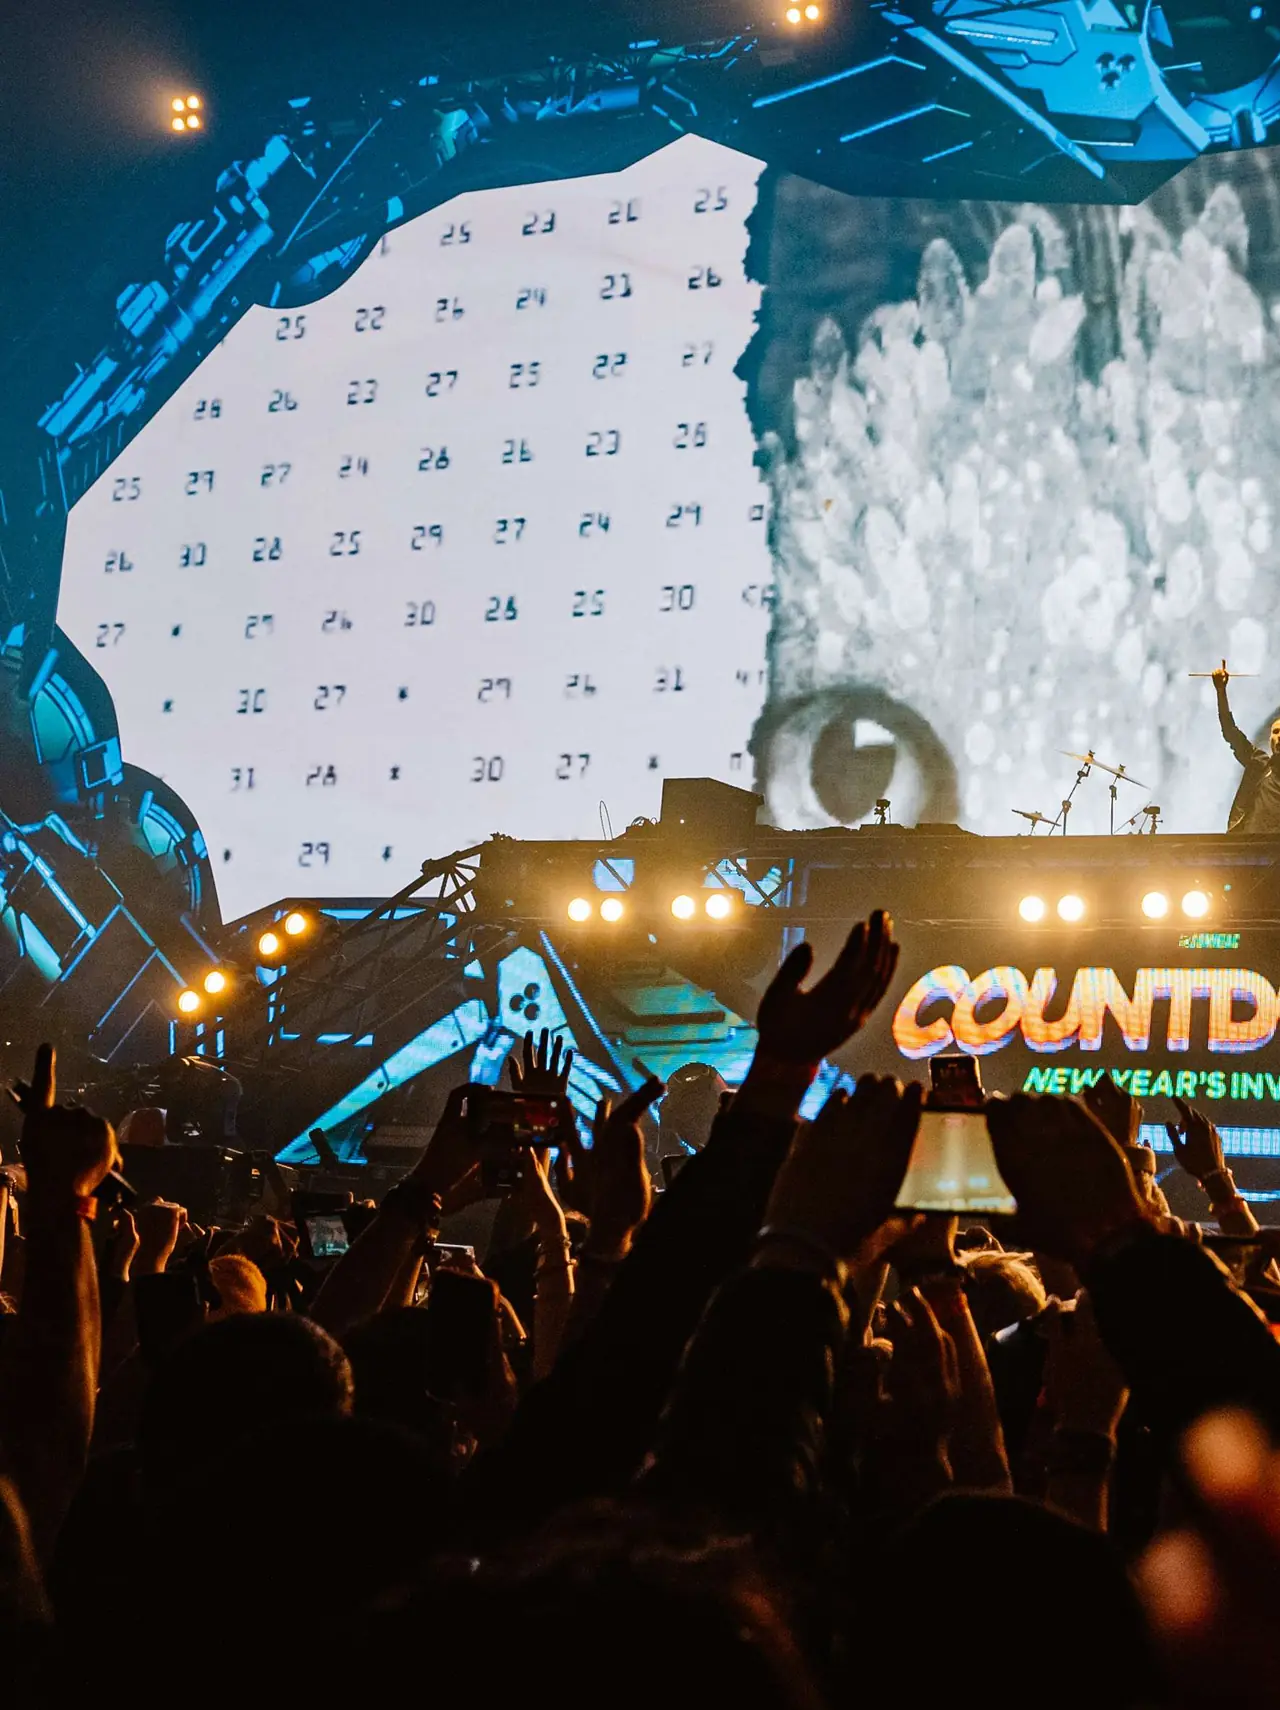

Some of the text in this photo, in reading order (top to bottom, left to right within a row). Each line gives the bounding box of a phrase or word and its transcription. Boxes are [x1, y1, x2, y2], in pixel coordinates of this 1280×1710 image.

[693, 185, 729, 215] 25
[275, 314, 307, 342] 25
[354, 304, 387, 333] 22
[687, 265, 724, 291] 26
[267, 388, 299, 414] 26
[424, 369, 459, 399] 27
[112, 476, 142, 503] 25
[328, 529, 362, 557] 25
[410, 523, 445, 552] 29
[95, 622, 126, 649] 27
[403, 599, 436, 628] 30
[571, 588, 606, 619] 25
[659, 583, 696, 613] 30
[313, 683, 348, 712] 27
[469, 754, 505, 784] 30
[555, 752, 592, 781] 27
[297, 841, 332, 868] 29
[1022, 1066, 1105, 1095] NEW
[1111, 1068, 1227, 1100] YEAR'S
